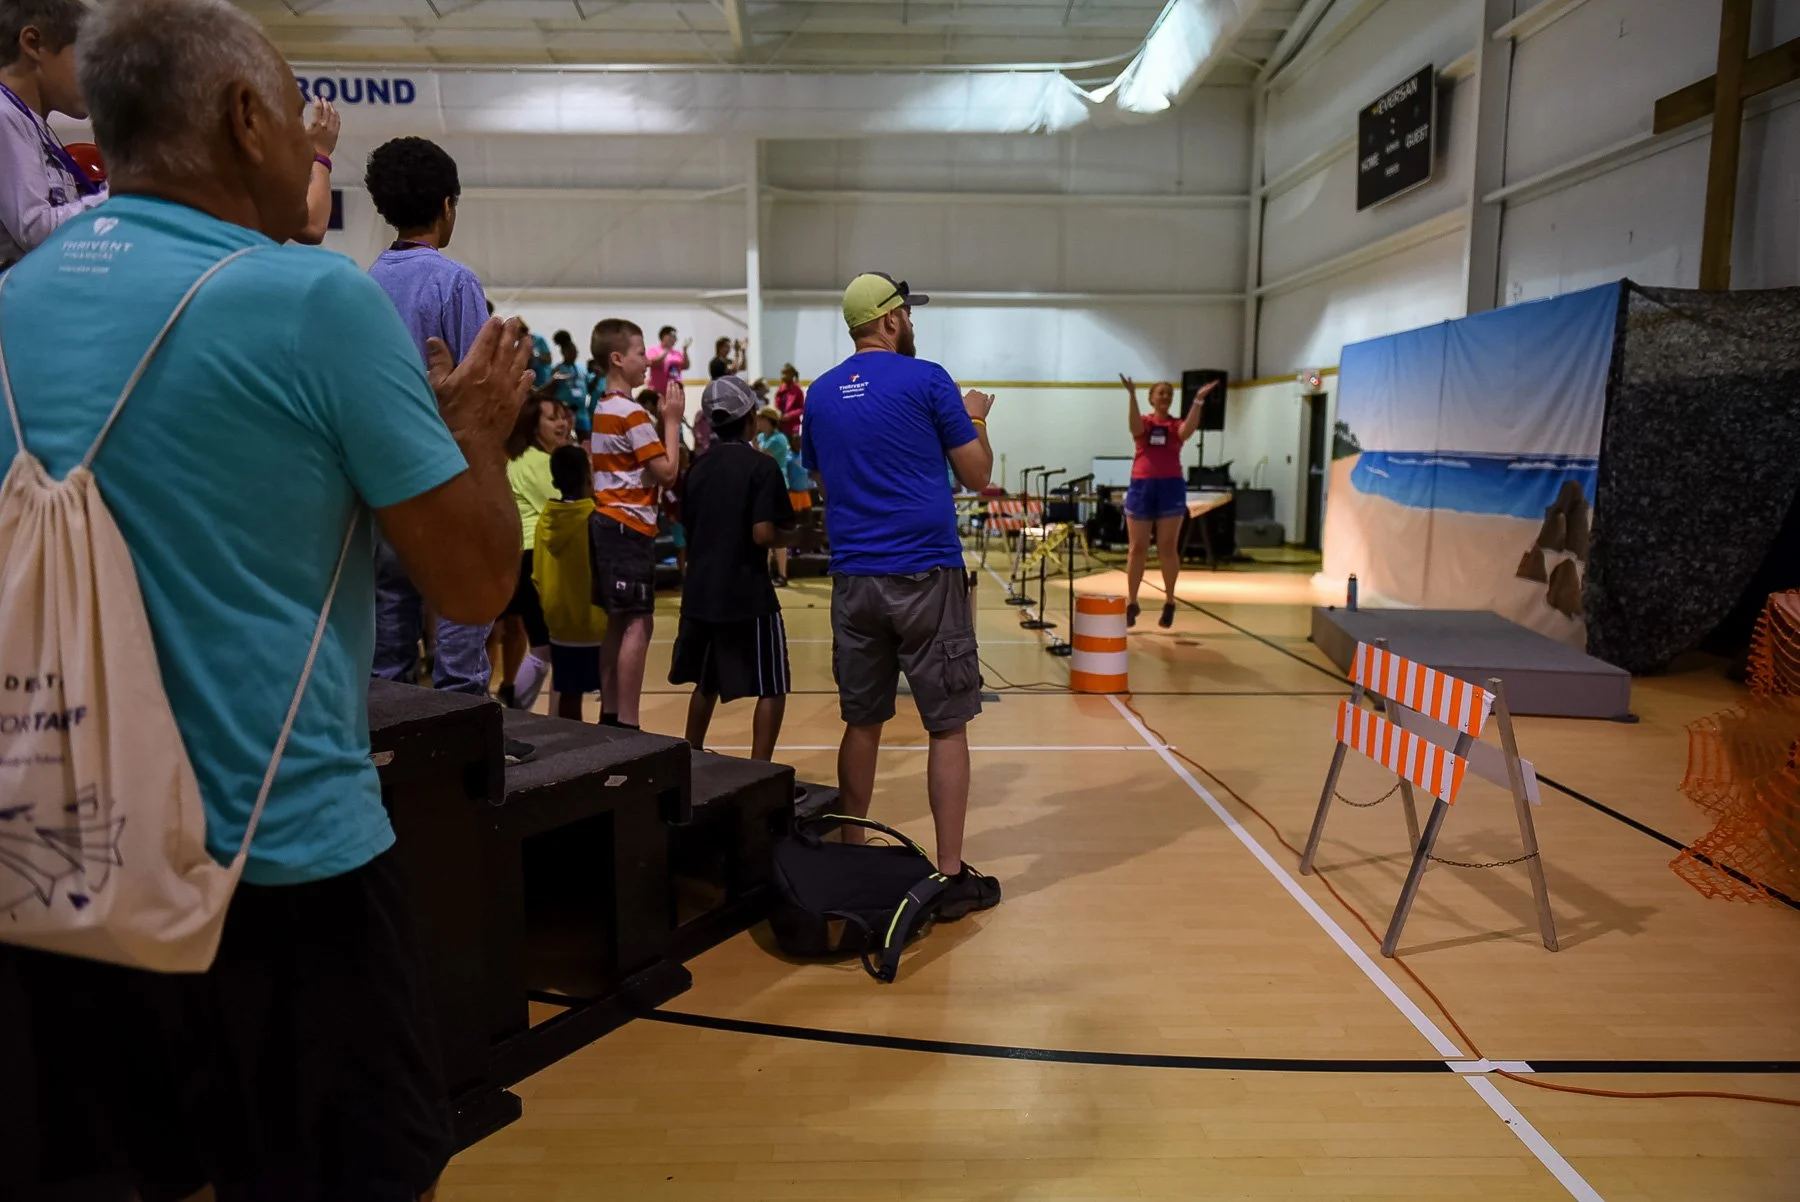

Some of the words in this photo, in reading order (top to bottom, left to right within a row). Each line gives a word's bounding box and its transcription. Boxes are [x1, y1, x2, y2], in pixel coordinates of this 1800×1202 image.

[1378, 77, 1418, 114] EVERSAN
[1361, 152, 1380, 174] HOME
[1405, 123, 1429, 149] GUEST
[62, 240, 134, 253] THRIVENT
